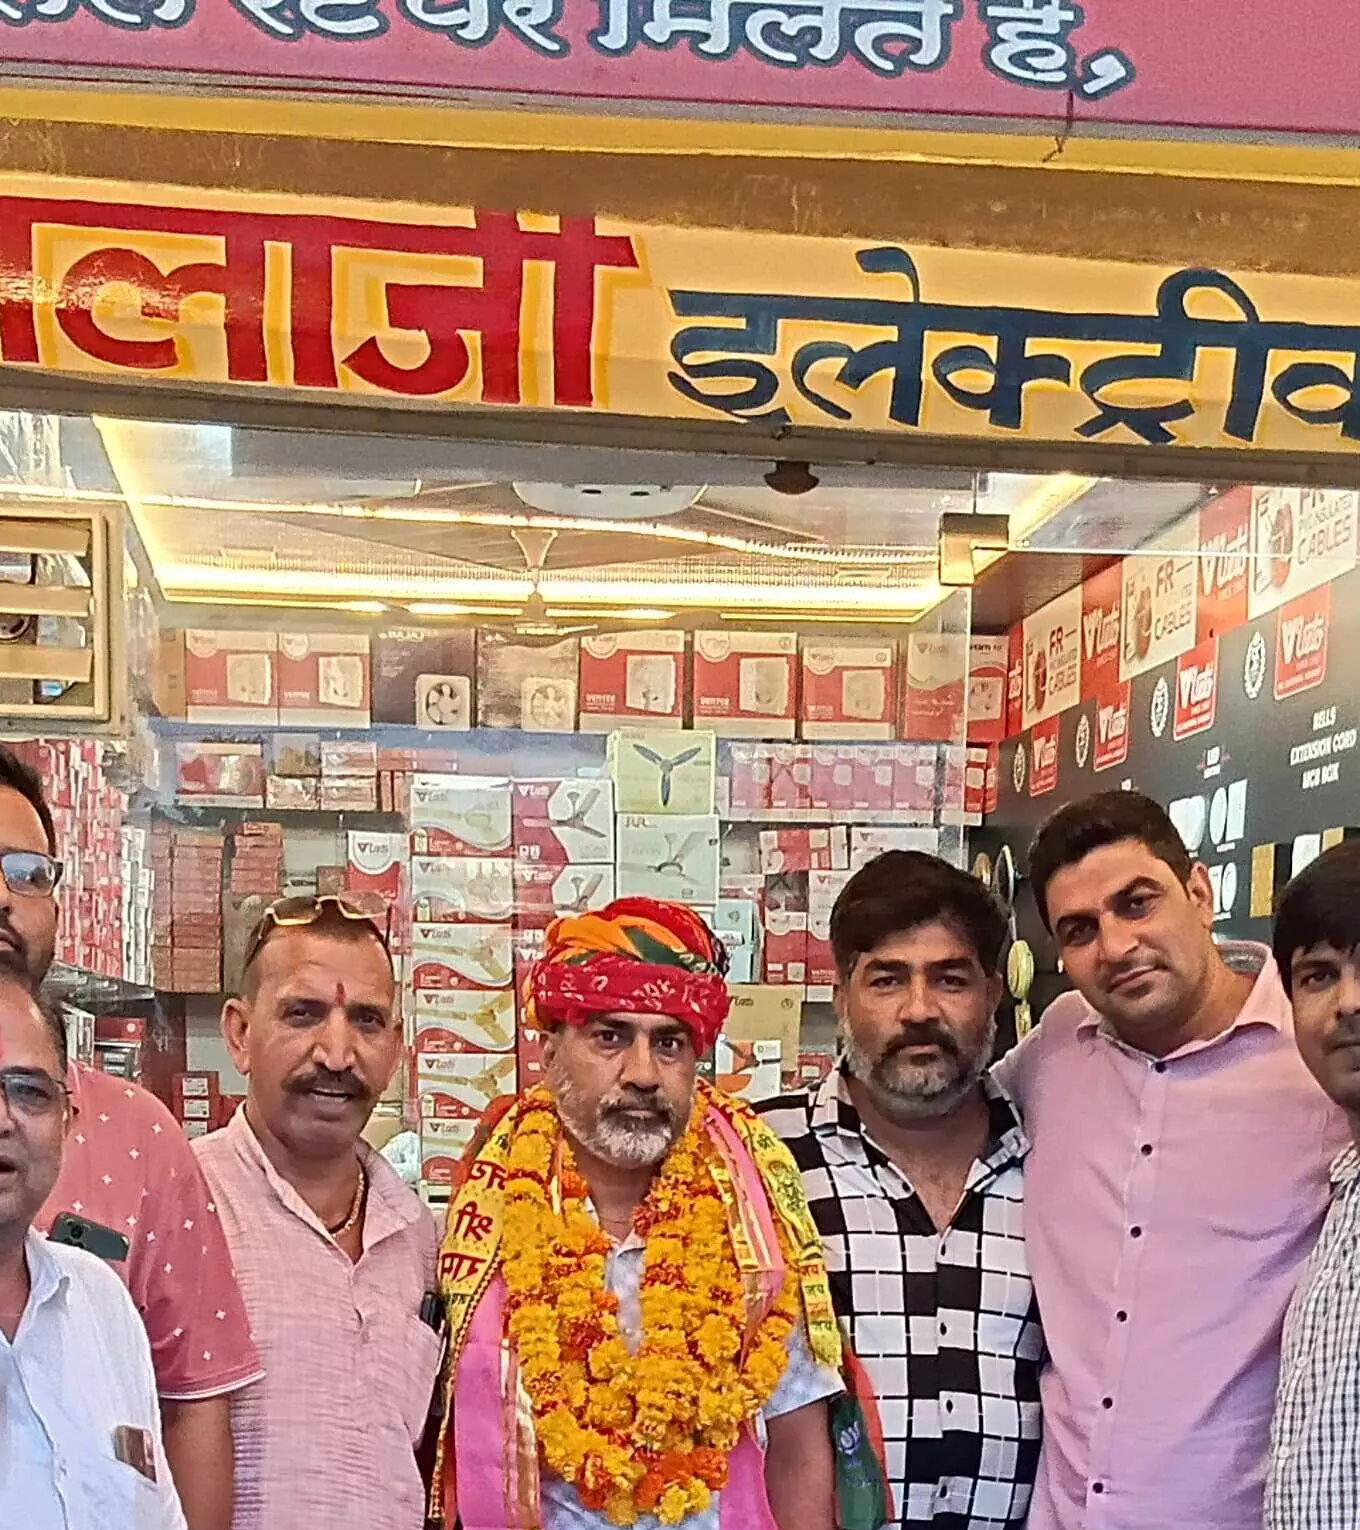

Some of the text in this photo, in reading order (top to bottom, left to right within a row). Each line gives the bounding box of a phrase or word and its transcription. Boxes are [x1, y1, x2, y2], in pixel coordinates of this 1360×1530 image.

[1297, 513, 1353, 566] CABLES
[1155, 558, 1174, 598] FR
[1049, 625, 1064, 657] FR
